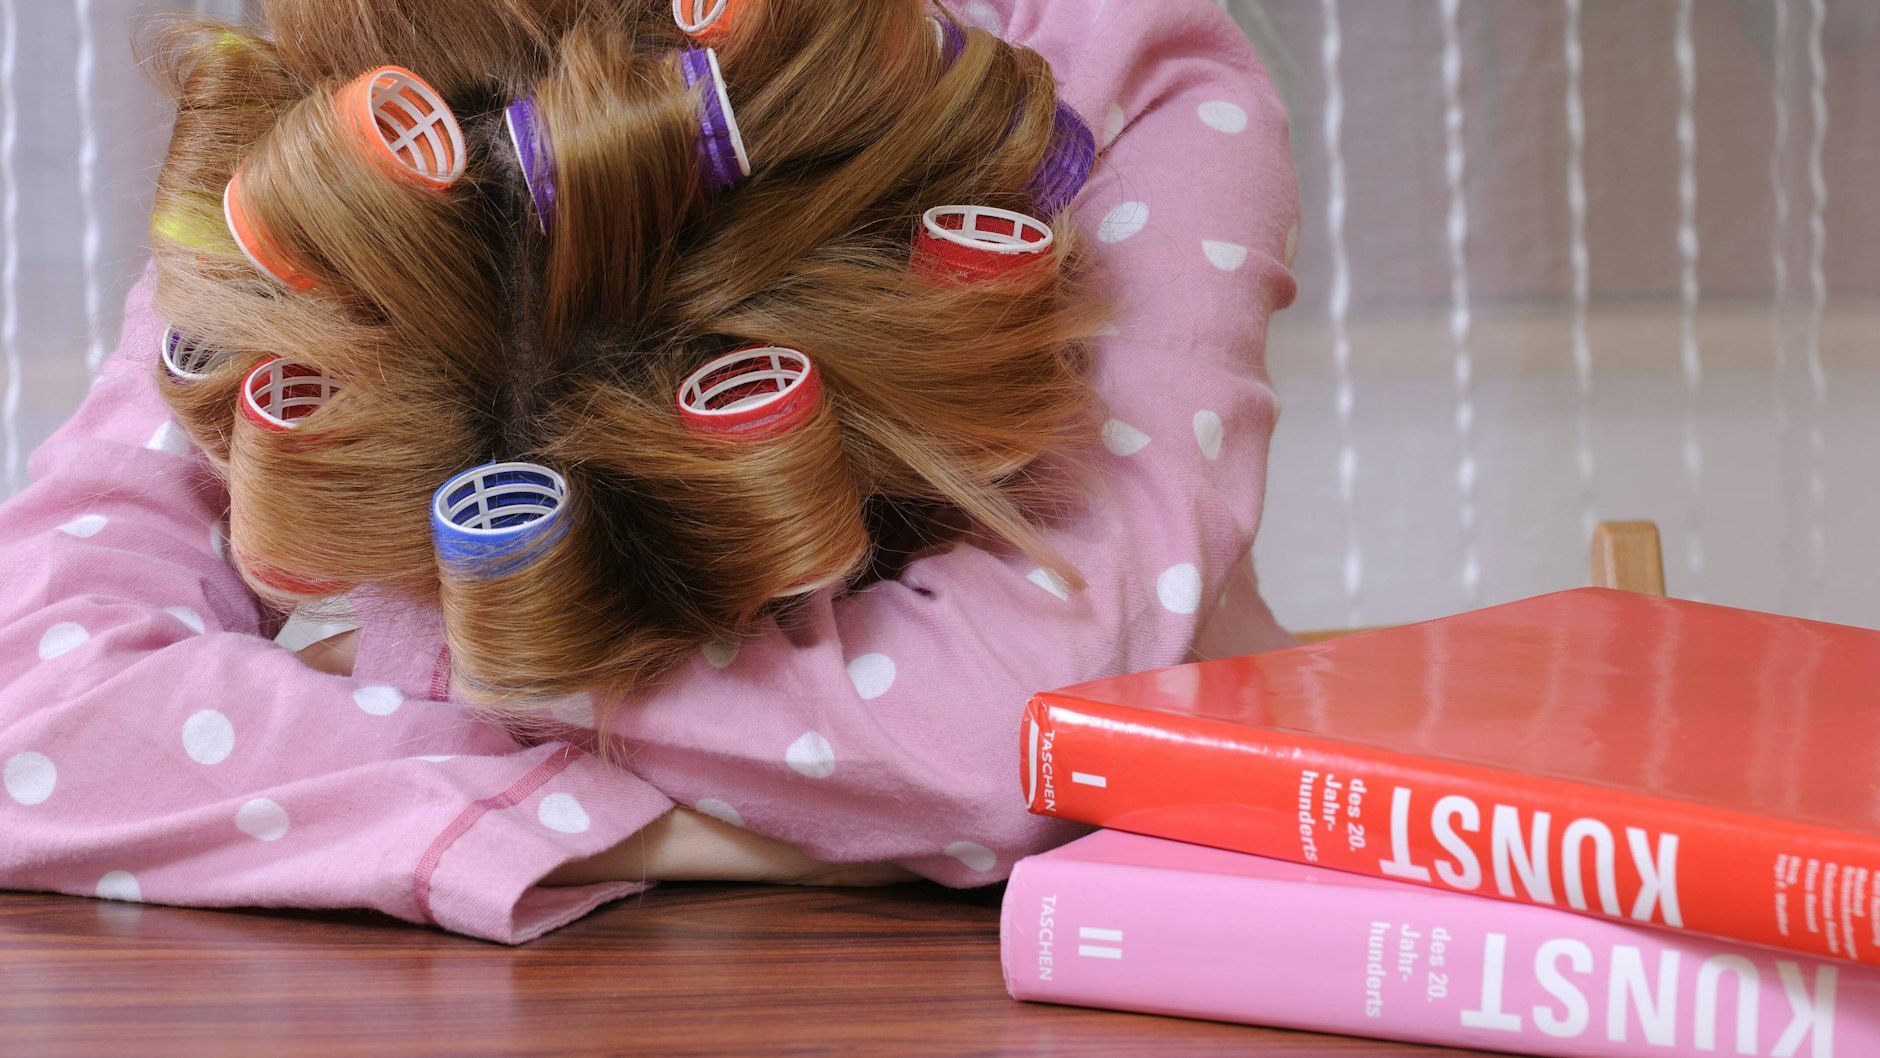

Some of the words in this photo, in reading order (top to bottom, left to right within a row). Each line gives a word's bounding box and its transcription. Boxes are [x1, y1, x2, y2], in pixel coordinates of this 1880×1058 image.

[1042, 730, 1056, 812] TASCHEN
[1071, 771, 1107, 789] I
[1347, 778, 1367, 818] des
[1298, 769, 1319, 862] hunderts
[1322, 773, 1343, 832] Jahr-
[1347, 822, 1366, 851] 20.
[1378, 786, 1684, 928] KUNST
[1039, 893, 1057, 981] TASCHEN
[1078, 926, 1123, 960] II
[1398, 923, 1422, 983] Jahr-
[1428, 927, 1452, 967] des
[1365, 921, 1392, 1018] hunderts
[1426, 971, 1449, 1002] 20.
[1460, 932, 1840, 1058] KUNST
